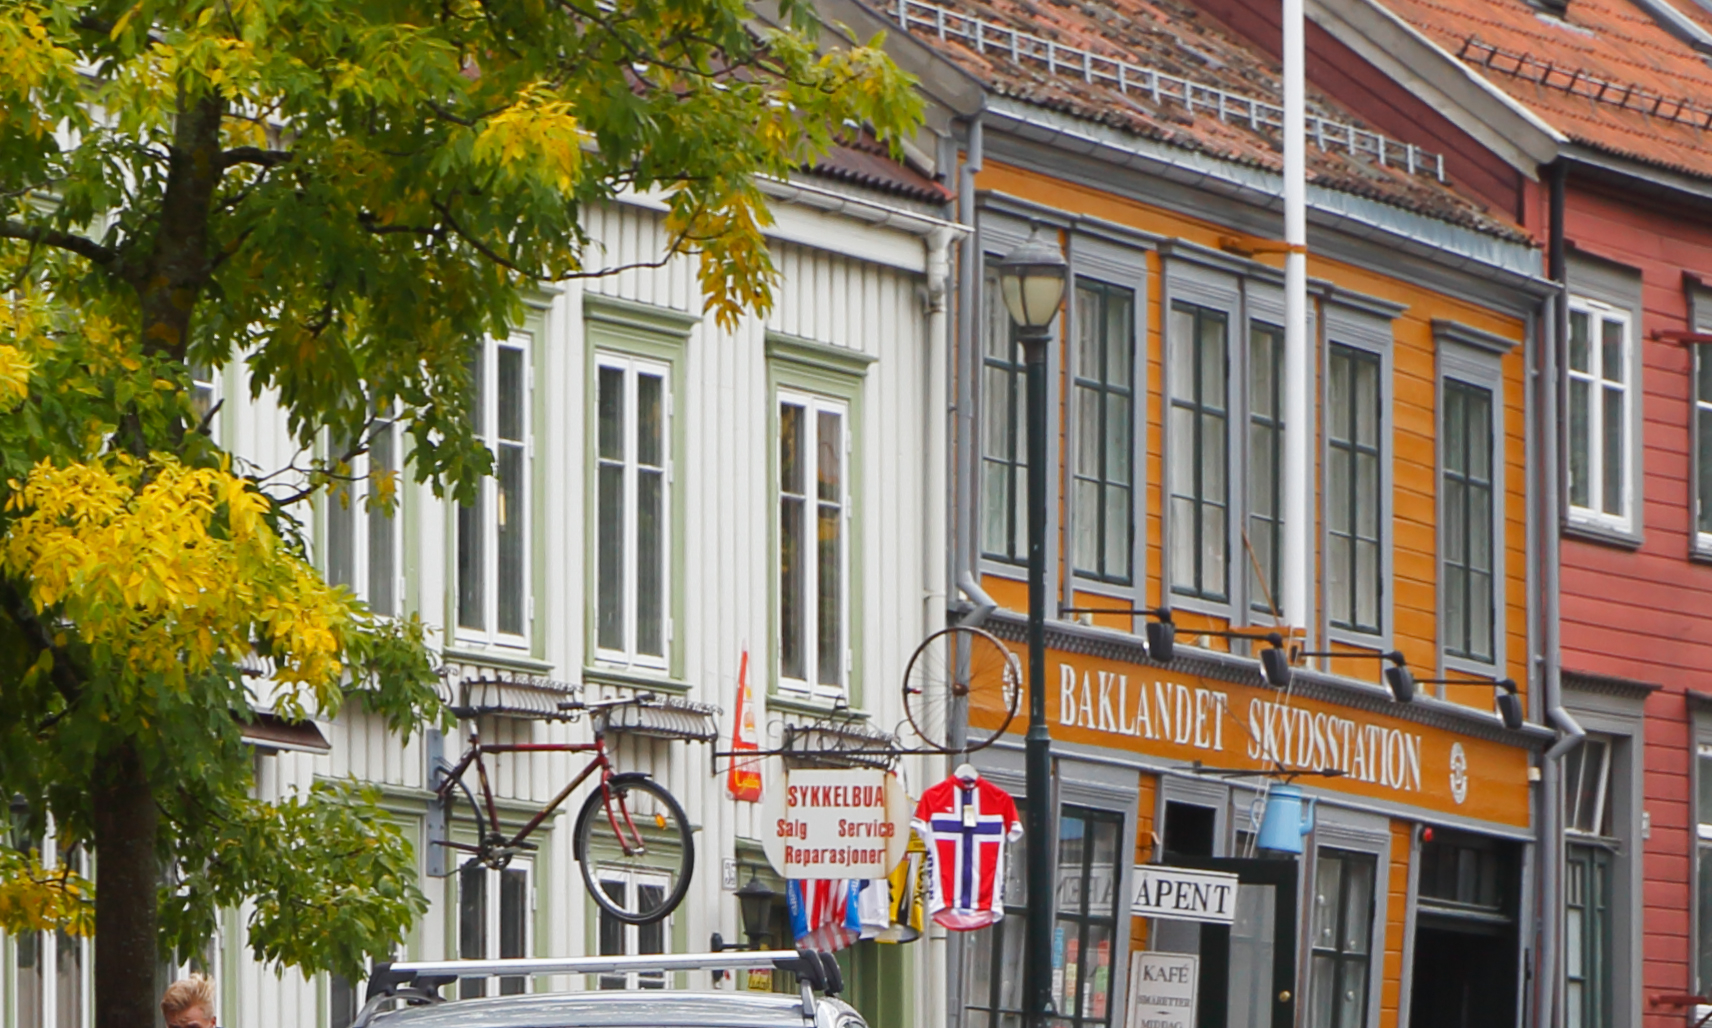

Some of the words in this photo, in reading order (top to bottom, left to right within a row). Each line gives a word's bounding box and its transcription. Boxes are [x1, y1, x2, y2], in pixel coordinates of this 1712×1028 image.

[1059, 663, 1228, 751] BAKLANDET
[1248, 698, 1421, 792] SKYDSSTATION
[788, 785, 885, 807] SYKKELBUA
[776, 818, 808, 840] Salg
[838, 818, 895, 838] Service
[785, 845, 887, 868] Reparasjoner
[1143, 963, 1190, 984] KAFÉ
